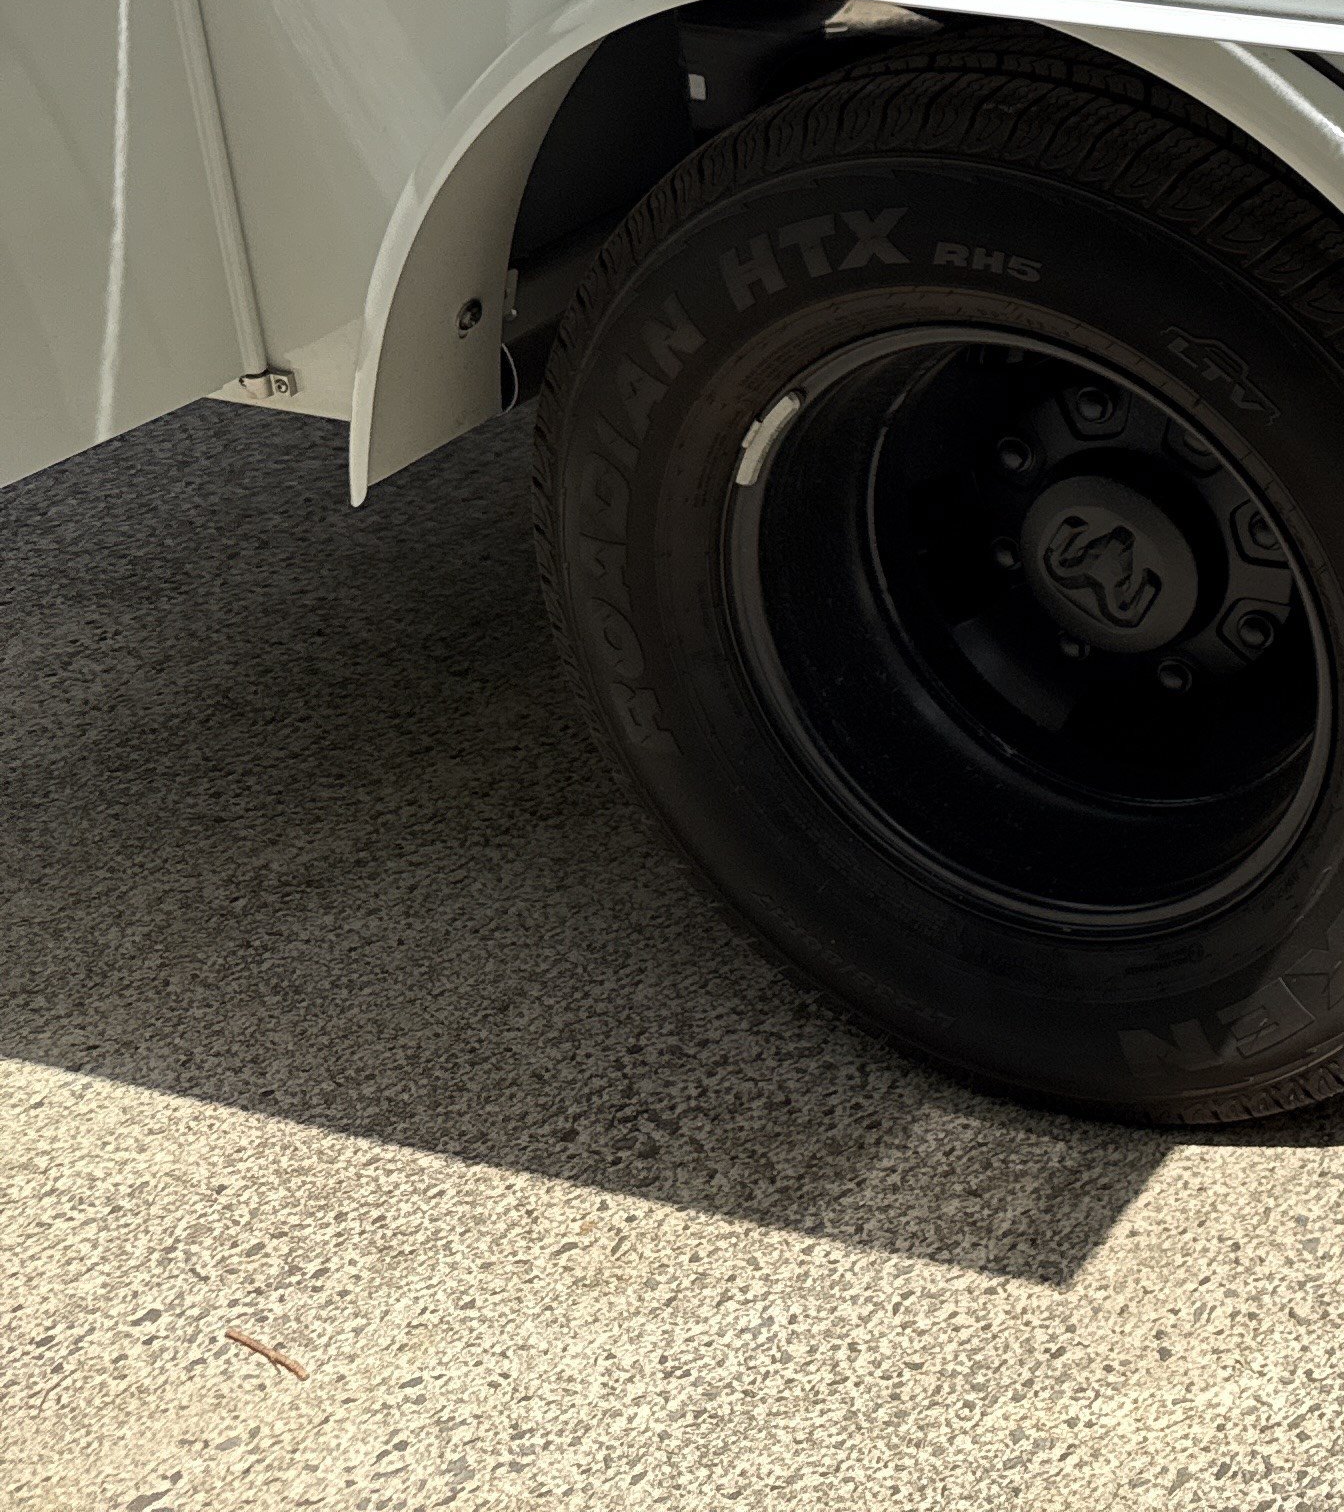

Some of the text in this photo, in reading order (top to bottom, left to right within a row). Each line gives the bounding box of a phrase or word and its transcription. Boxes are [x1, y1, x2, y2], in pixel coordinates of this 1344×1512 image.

[578, 293, 707, 757] ROADIAN
[719, 207, 911, 312] HTX
[933, 242, 1043, 283] RH5
[1167, 337, 1266, 411] LTV
